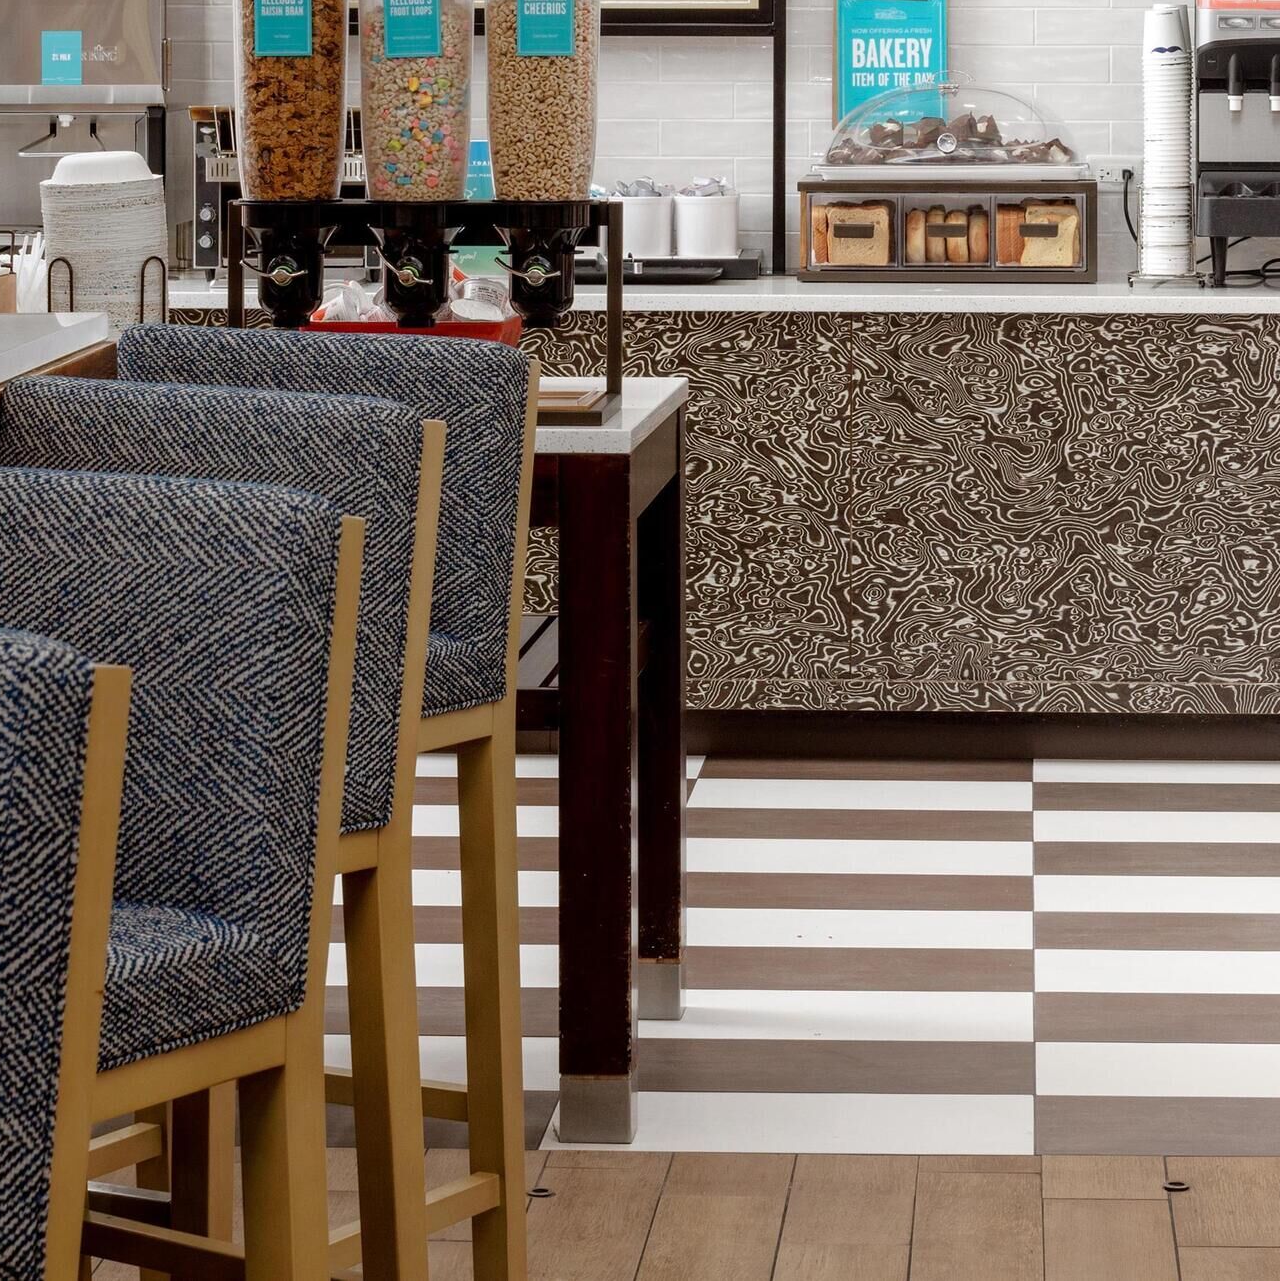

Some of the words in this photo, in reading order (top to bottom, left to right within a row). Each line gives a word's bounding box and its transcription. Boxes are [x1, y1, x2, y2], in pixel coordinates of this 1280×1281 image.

[261, 6, 283, 16] RAISIN
[285, 6, 304, 16] BRAN
[524, 2, 567, 15] CHEERIOS
[852, 37, 933, 68] BAKERY
[852, 72, 874, 86] ITEM
[878, 72, 890, 86] OF
[893, 72, 912, 86] THE
